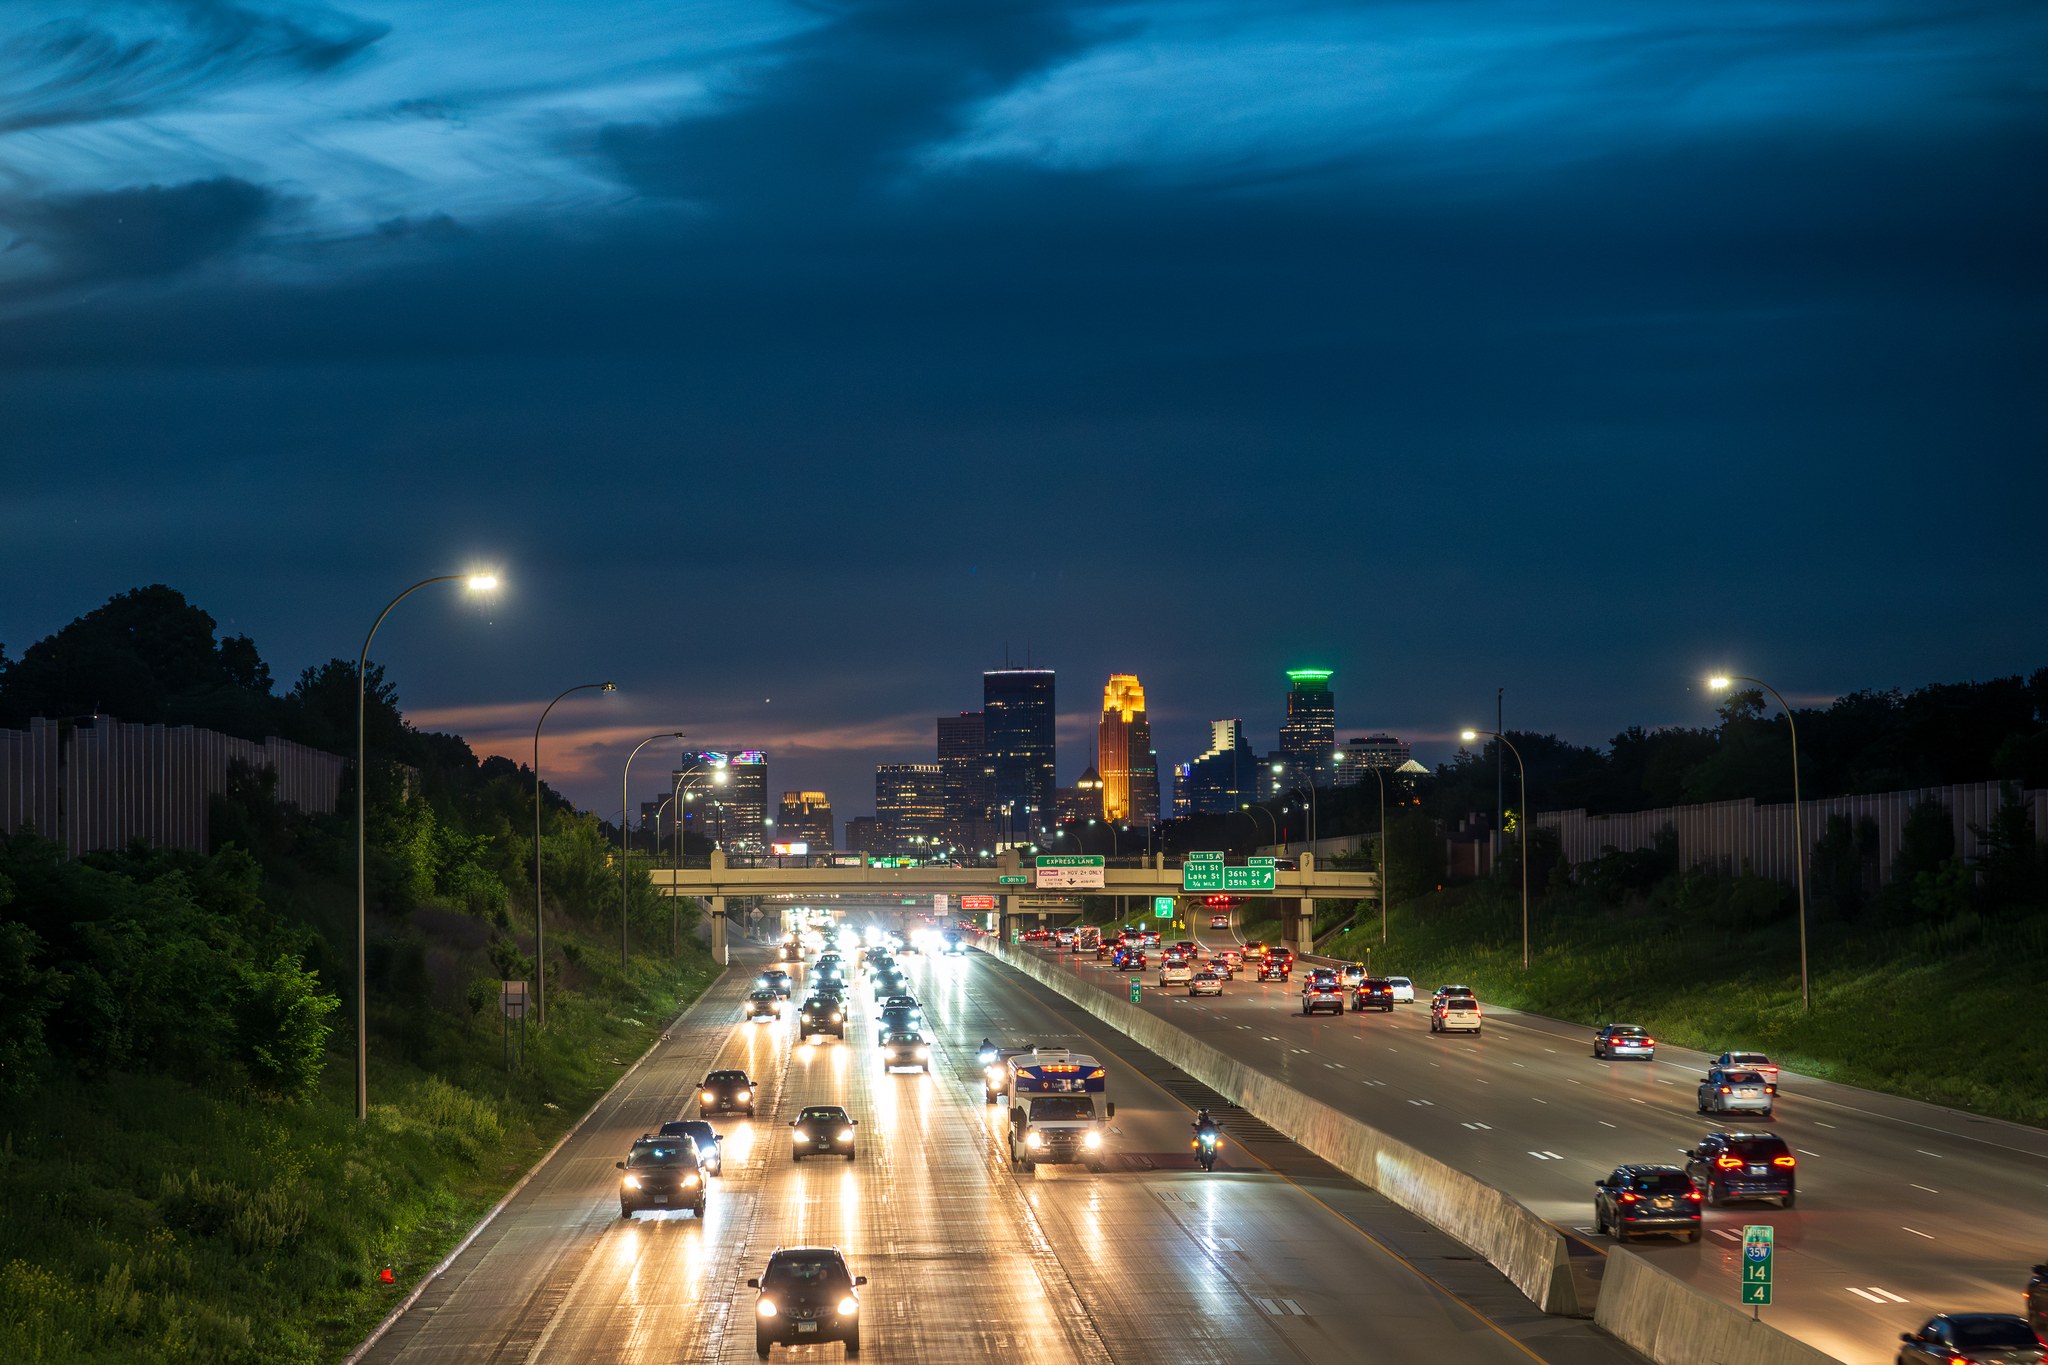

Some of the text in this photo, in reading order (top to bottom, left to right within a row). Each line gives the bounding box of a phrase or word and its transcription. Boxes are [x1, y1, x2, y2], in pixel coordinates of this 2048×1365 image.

[1749, 1248, 1767, 1256] 35W
[1749, 1266, 1766, 1280] 14
[1750, 1286, 1764, 1300] .4
